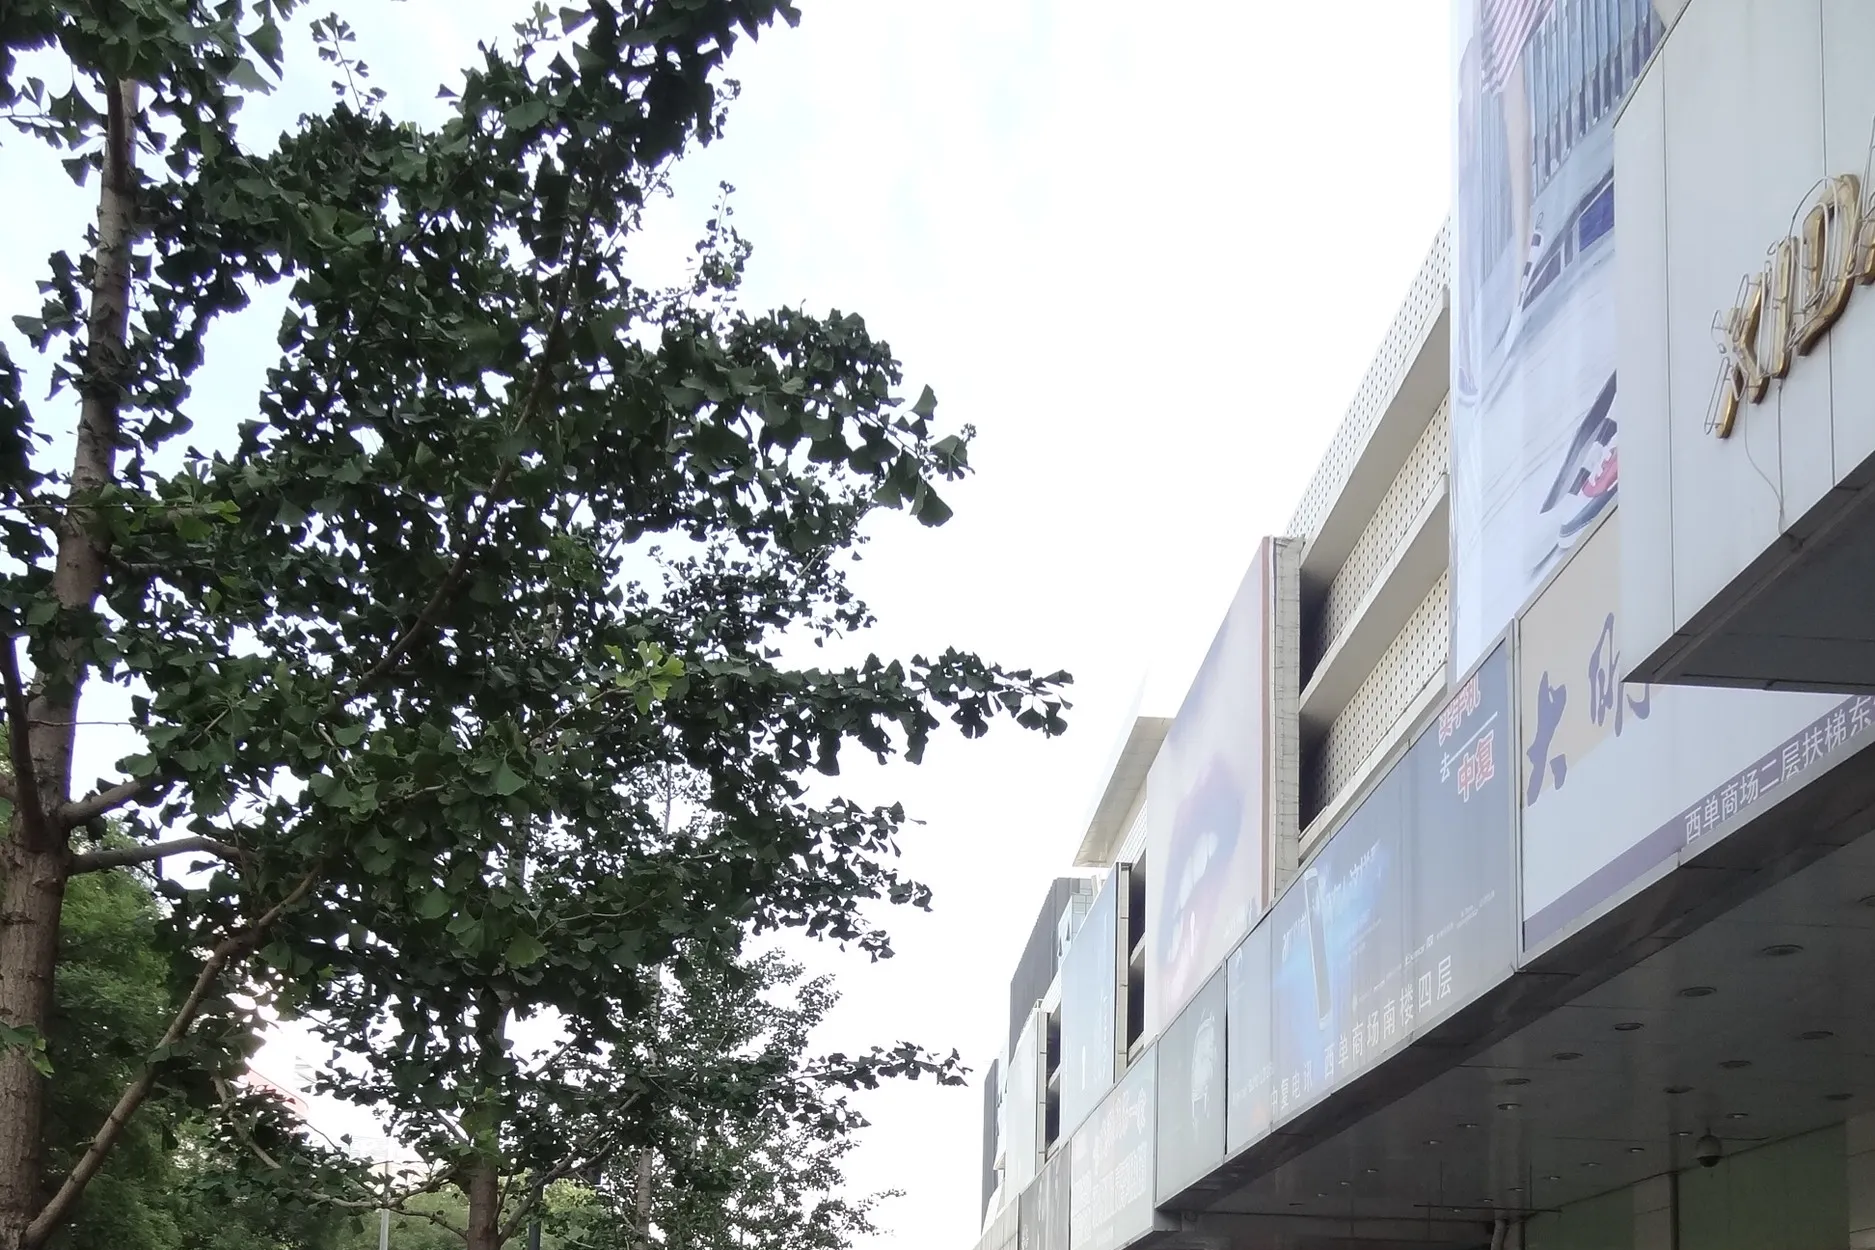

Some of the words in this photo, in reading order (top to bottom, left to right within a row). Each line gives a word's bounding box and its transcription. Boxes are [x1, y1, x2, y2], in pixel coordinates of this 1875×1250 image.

[1684, 696, 1875, 845] 西单商场二层扶梯东
[1324, 955, 1452, 1081] 西单商场南楼四层
